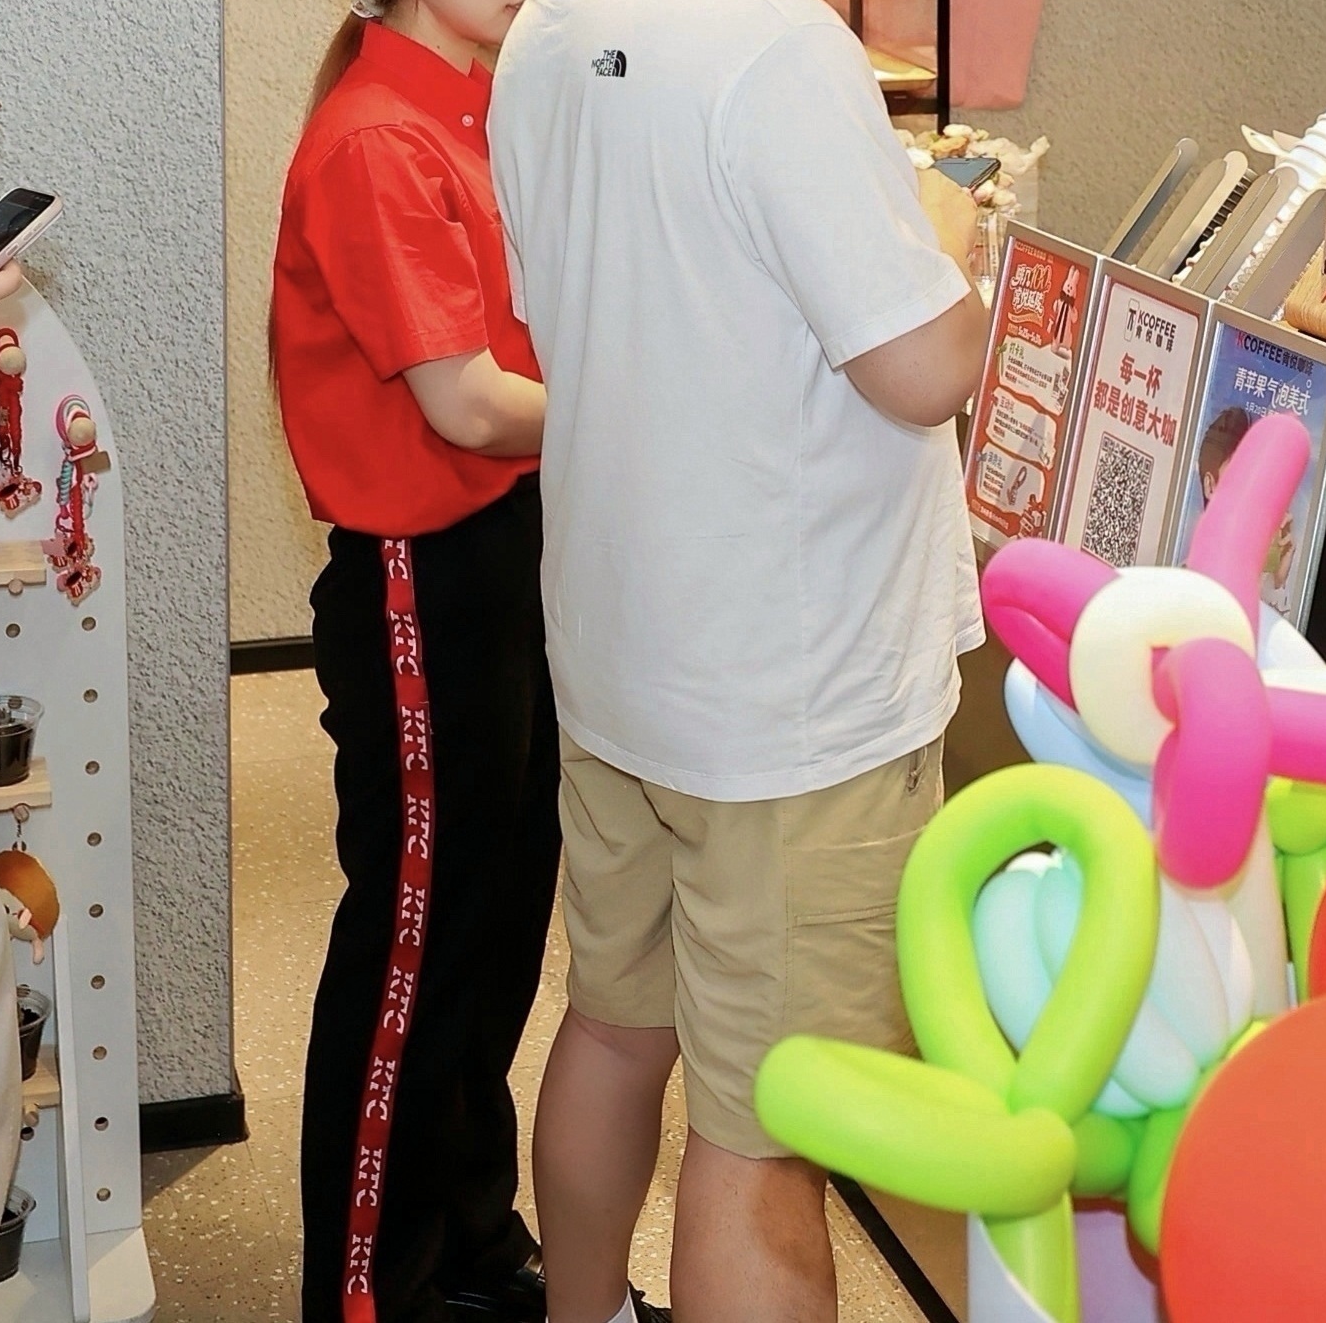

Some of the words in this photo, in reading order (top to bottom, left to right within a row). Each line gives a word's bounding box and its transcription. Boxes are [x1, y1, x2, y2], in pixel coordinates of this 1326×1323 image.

[591, 58, 614, 69] NORTH
[595, 67, 612, 77] FACE
[603, 49, 616, 59] THE
[1136, 309, 1177, 339] KCOFFEE
[1236, 330, 1283, 364] KCOFFEE
[1120, 352, 1163, 399] 每一杯
[1234, 366, 1311, 416] 青苹果气泡美式
[1092, 378, 1178, 448] 都是创意大咖
[384, 539, 409, 580] FC
[389, 609, 420, 677] KFC
[401, 705, 429, 771] KFC
[406, 793, 430, 860] KFC
[398, 881, 426, 947] KFC
[383, 965, 415, 1035] KFC
[365, 1056, 397, 1121] KFC
[355, 1145, 383, 1208] KFC
[346, 1233, 373, 1295] KFC
